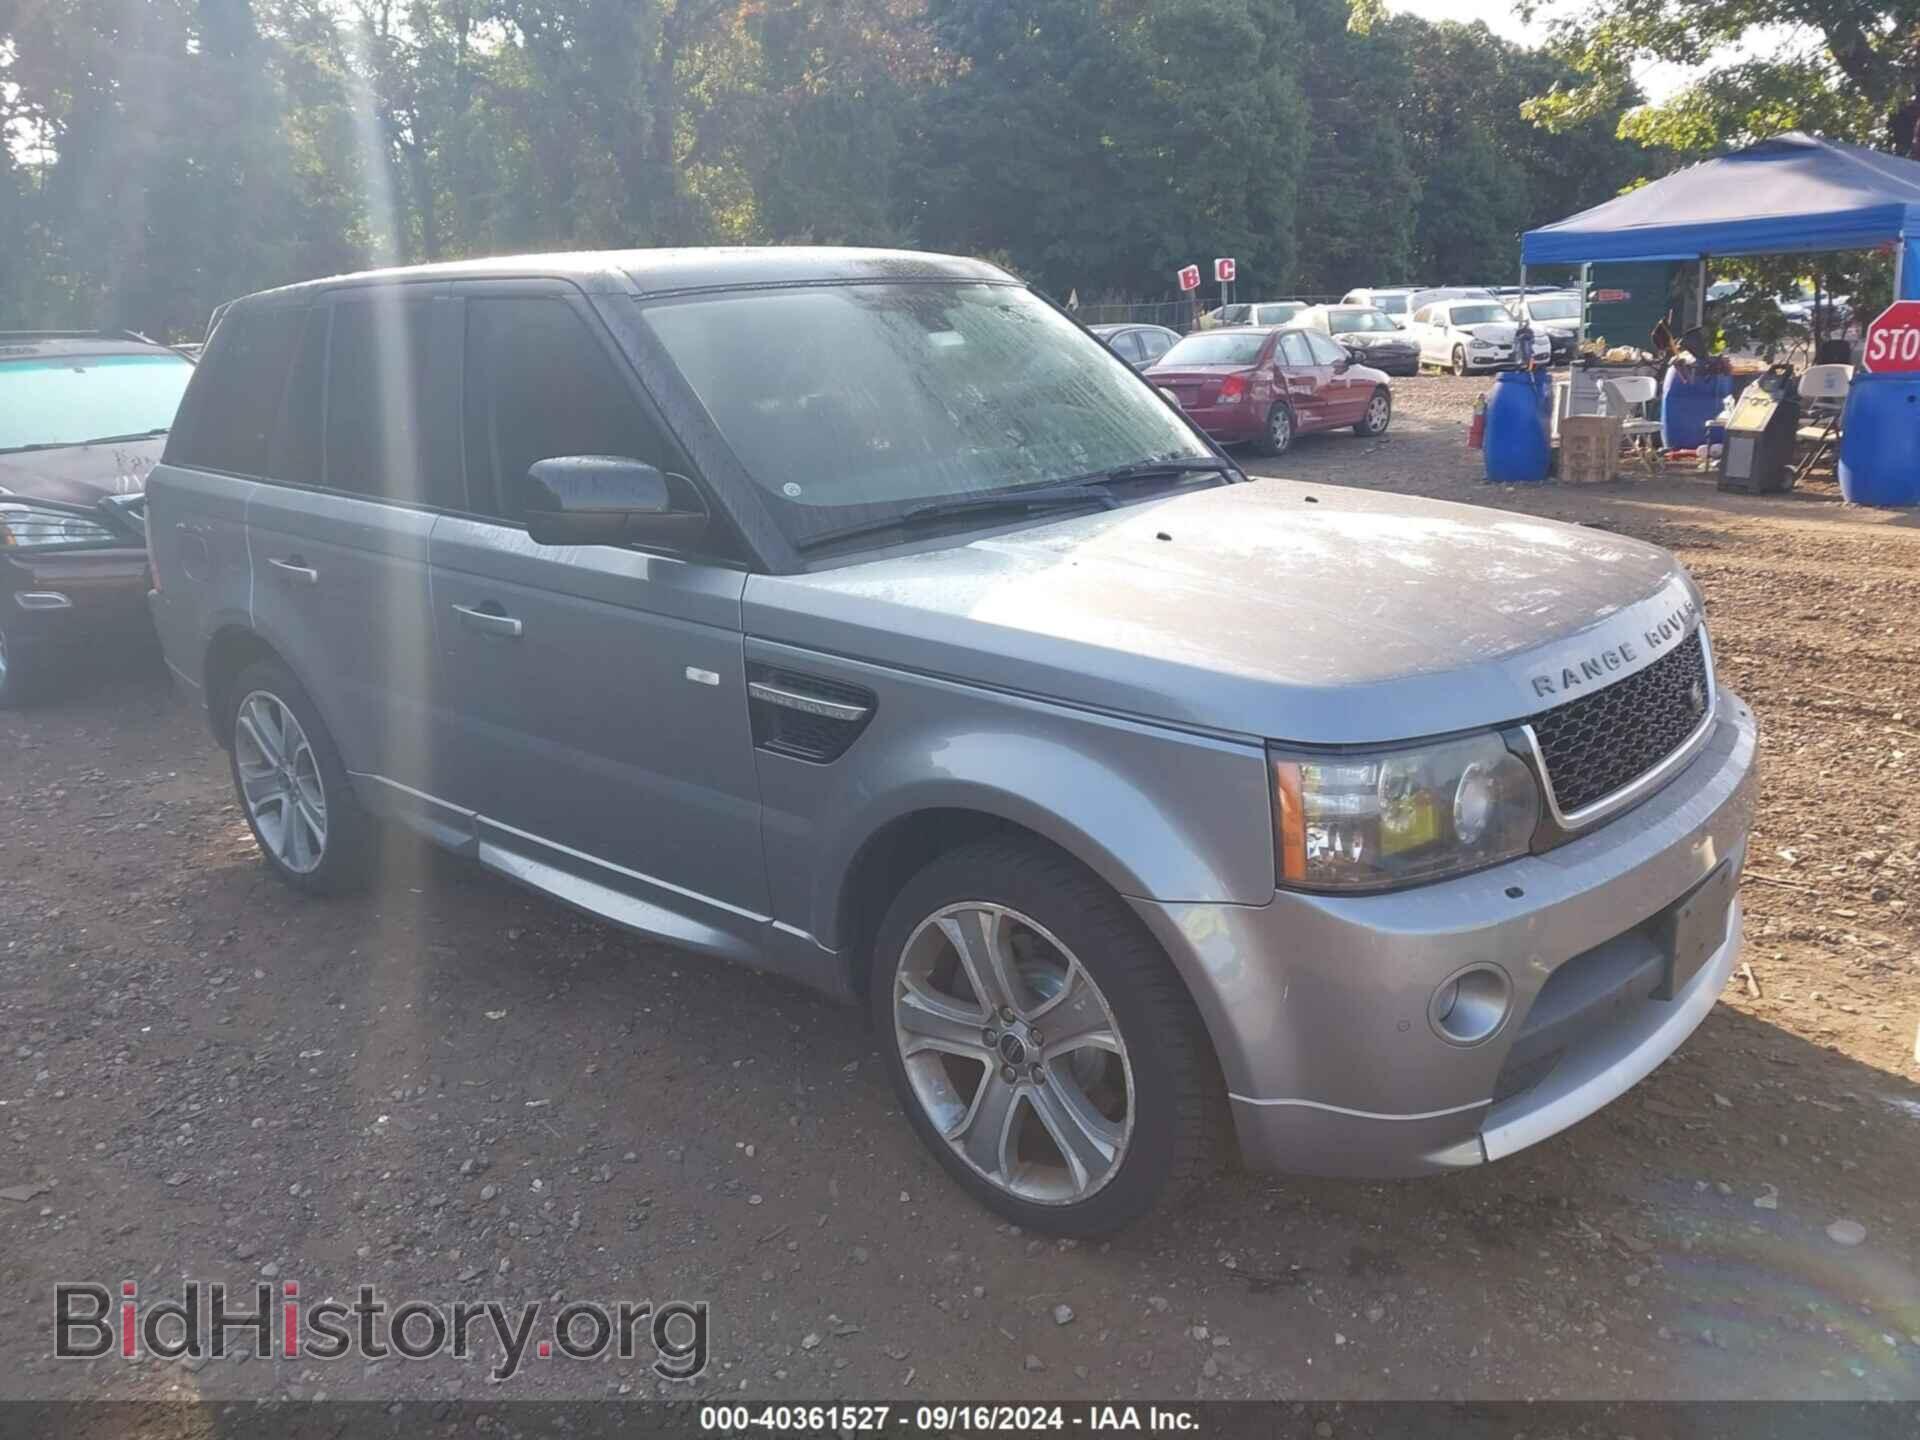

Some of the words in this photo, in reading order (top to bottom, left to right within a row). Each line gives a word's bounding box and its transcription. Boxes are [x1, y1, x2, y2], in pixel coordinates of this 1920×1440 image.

[1182, 267, 1199, 288] B
[1219, 260, 1235, 280] C
[1532, 643, 1637, 698] RANGE
